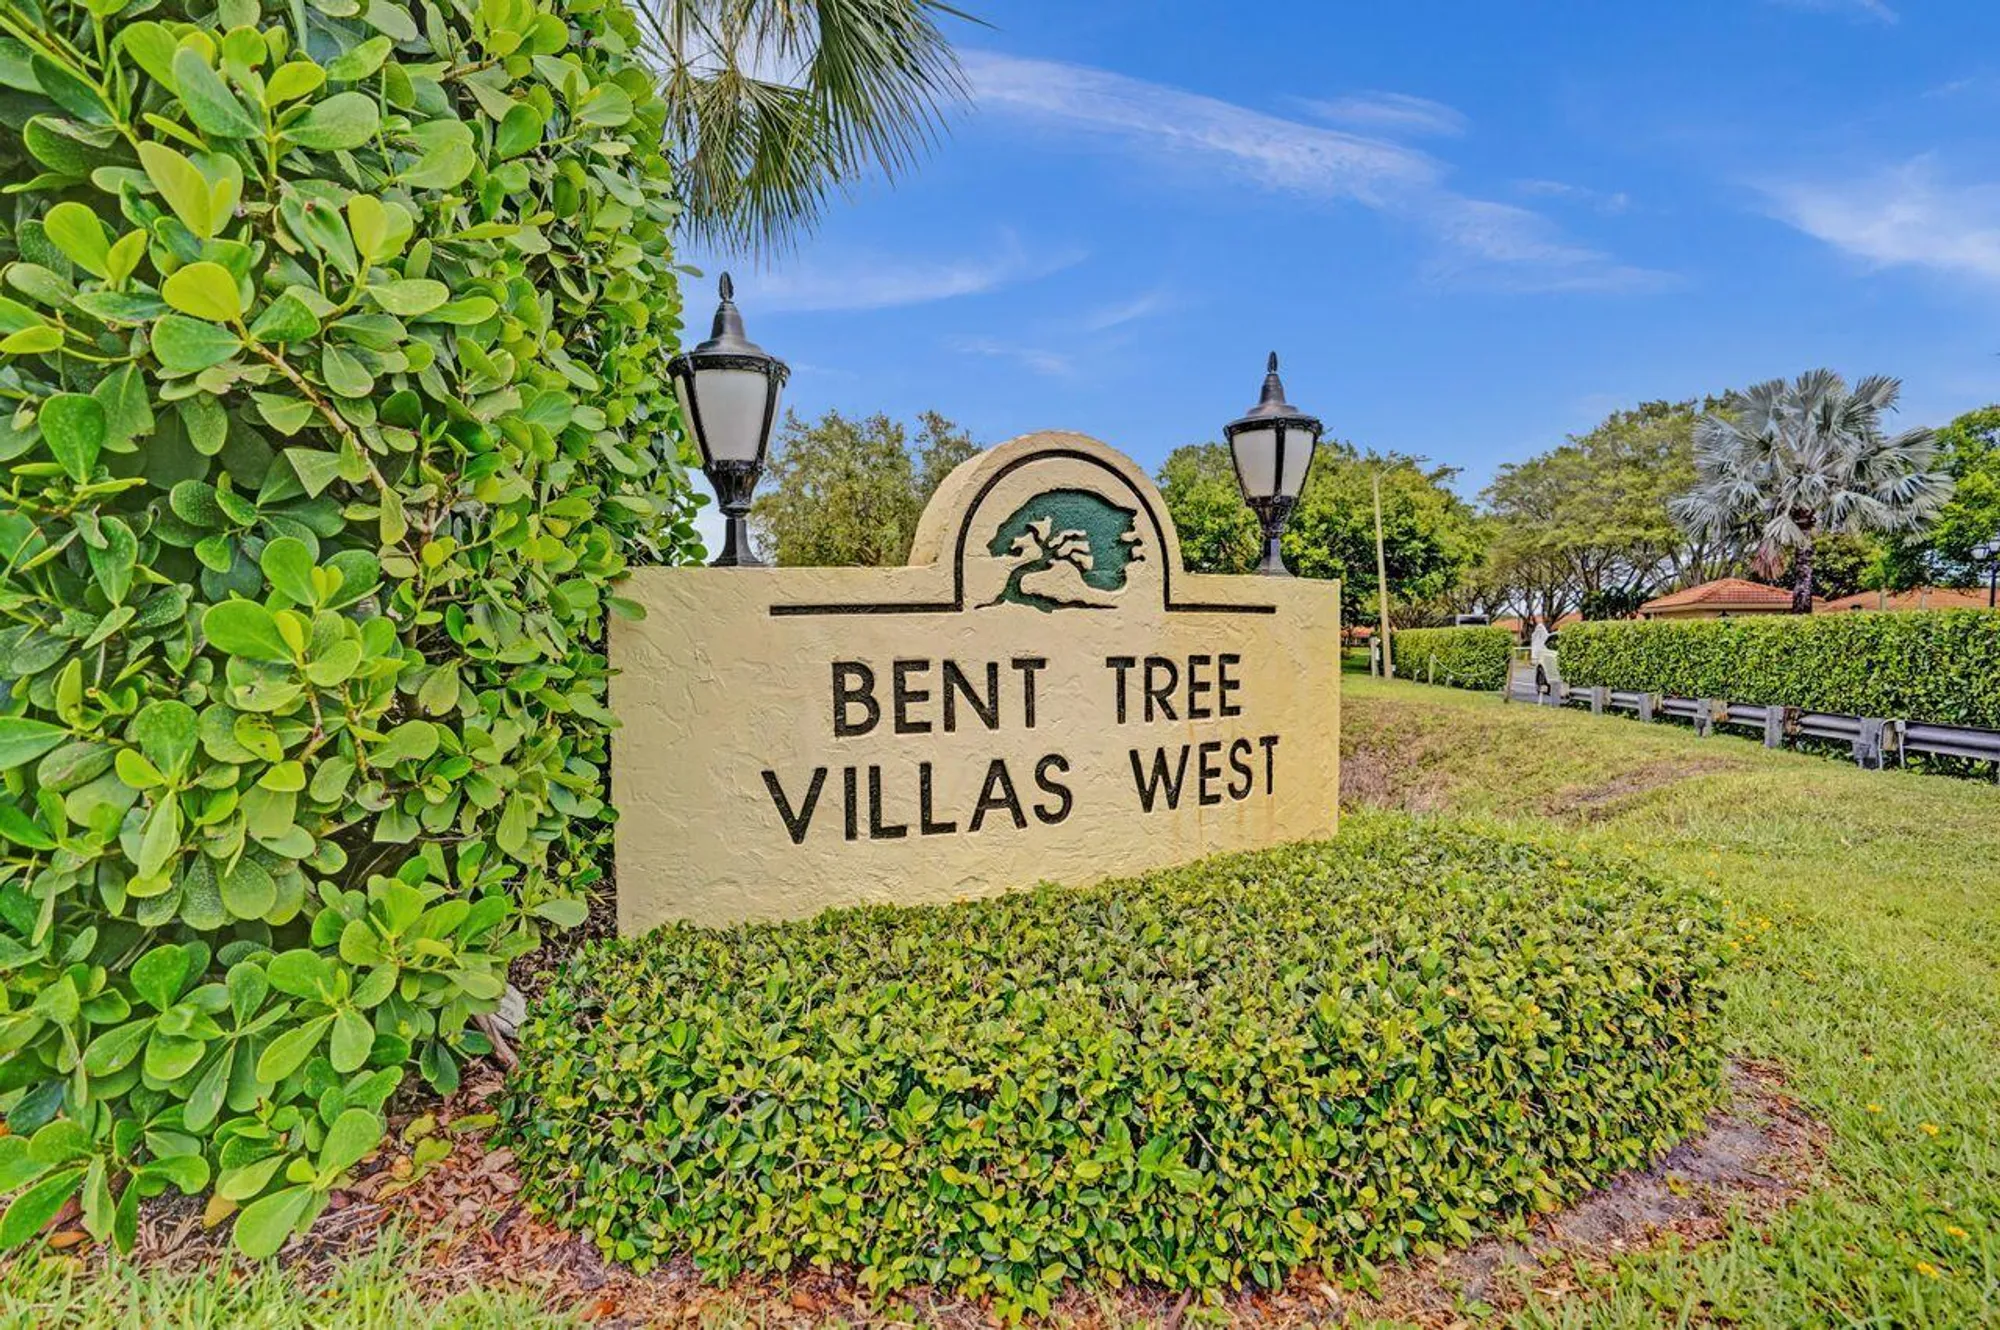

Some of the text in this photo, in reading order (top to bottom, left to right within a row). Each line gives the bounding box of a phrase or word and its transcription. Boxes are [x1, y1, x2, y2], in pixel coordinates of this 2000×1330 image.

[832, 653, 1242, 738] BENT TREE
[760, 734, 1280, 845] VILLAS WEST
